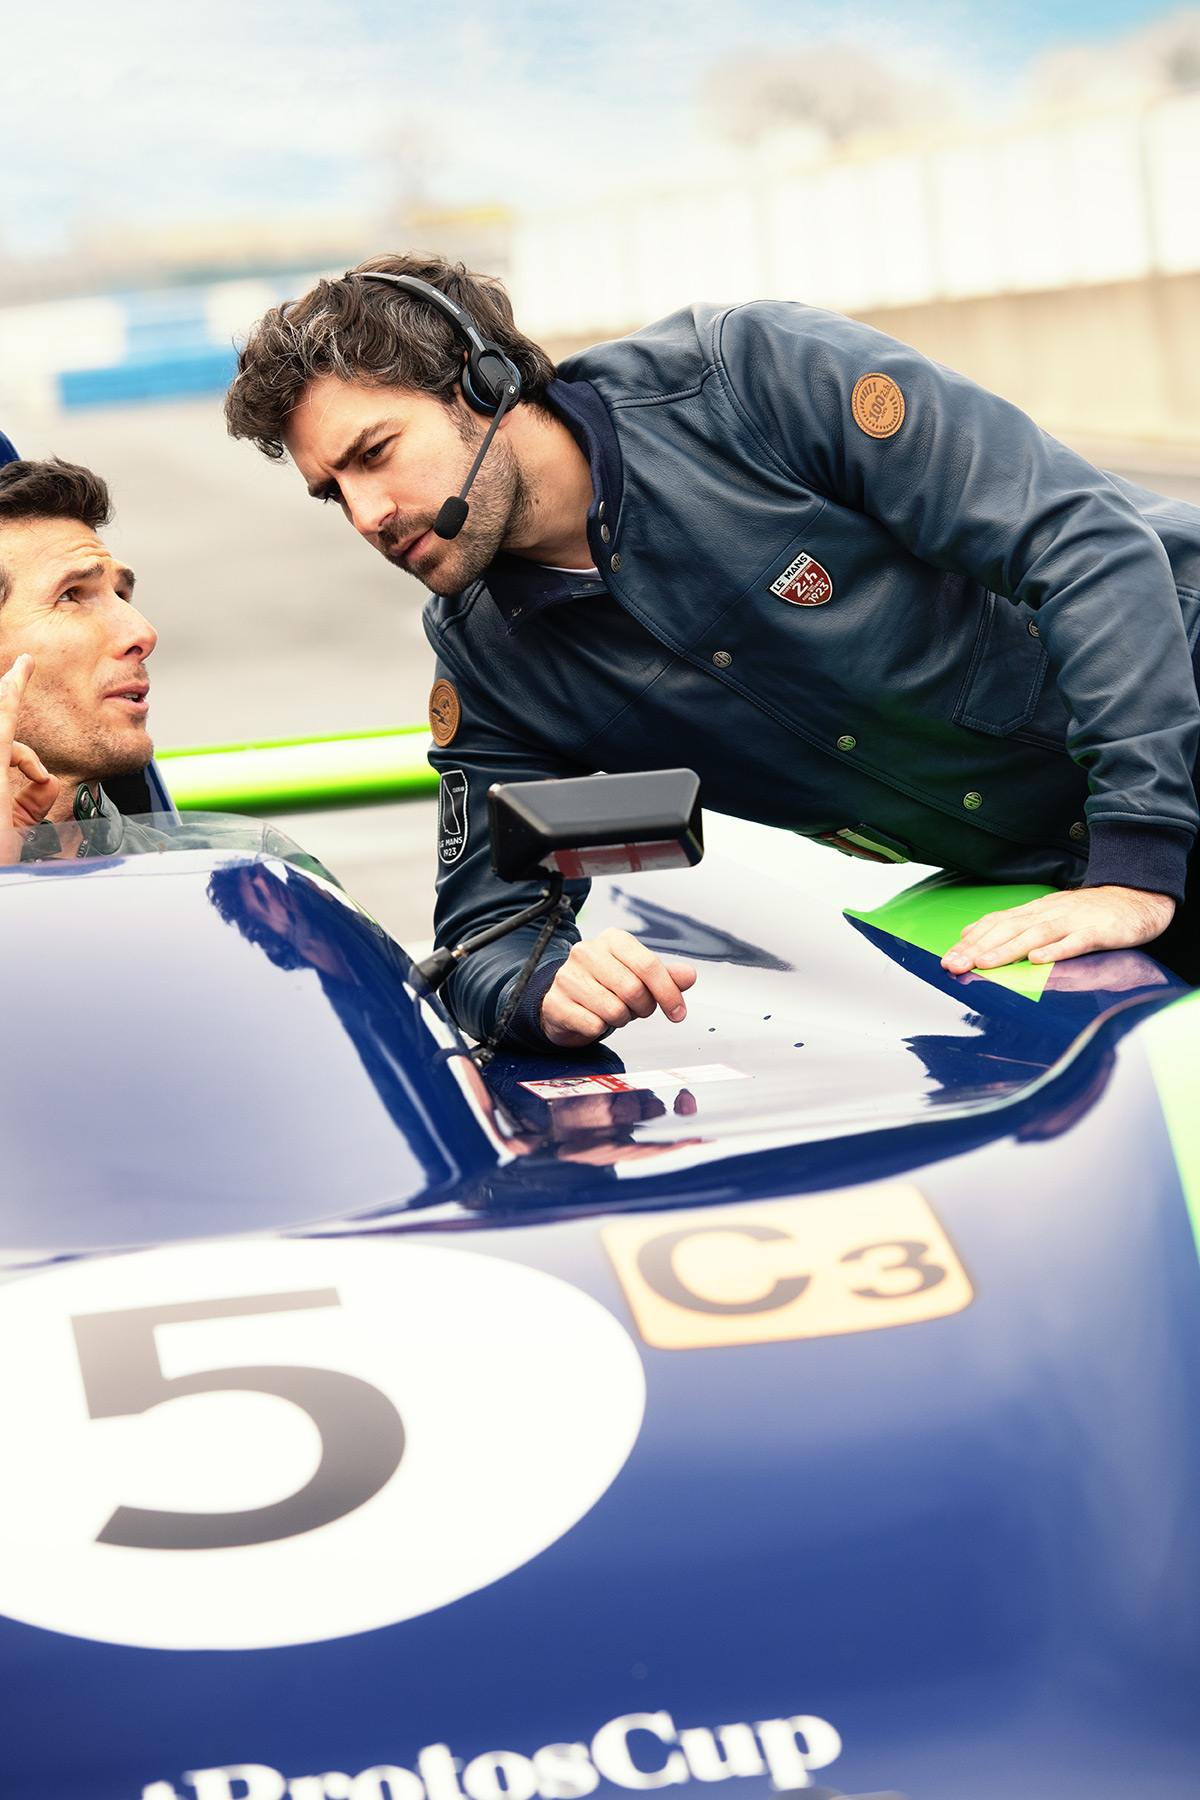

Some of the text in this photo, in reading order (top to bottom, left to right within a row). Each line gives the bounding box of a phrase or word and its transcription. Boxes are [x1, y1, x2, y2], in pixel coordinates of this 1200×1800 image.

[868, 395, 886, 422] 100
[772, 580, 785, 592] LE
[784, 555, 808, 580] MANS
[808, 582, 830, 603] 1923
[443, 847, 457, 857] 1923
[445, 836, 463, 846] MANS
[637, 1225, 946, 1316] C 3
[70, 1287, 406, 1551] 5
